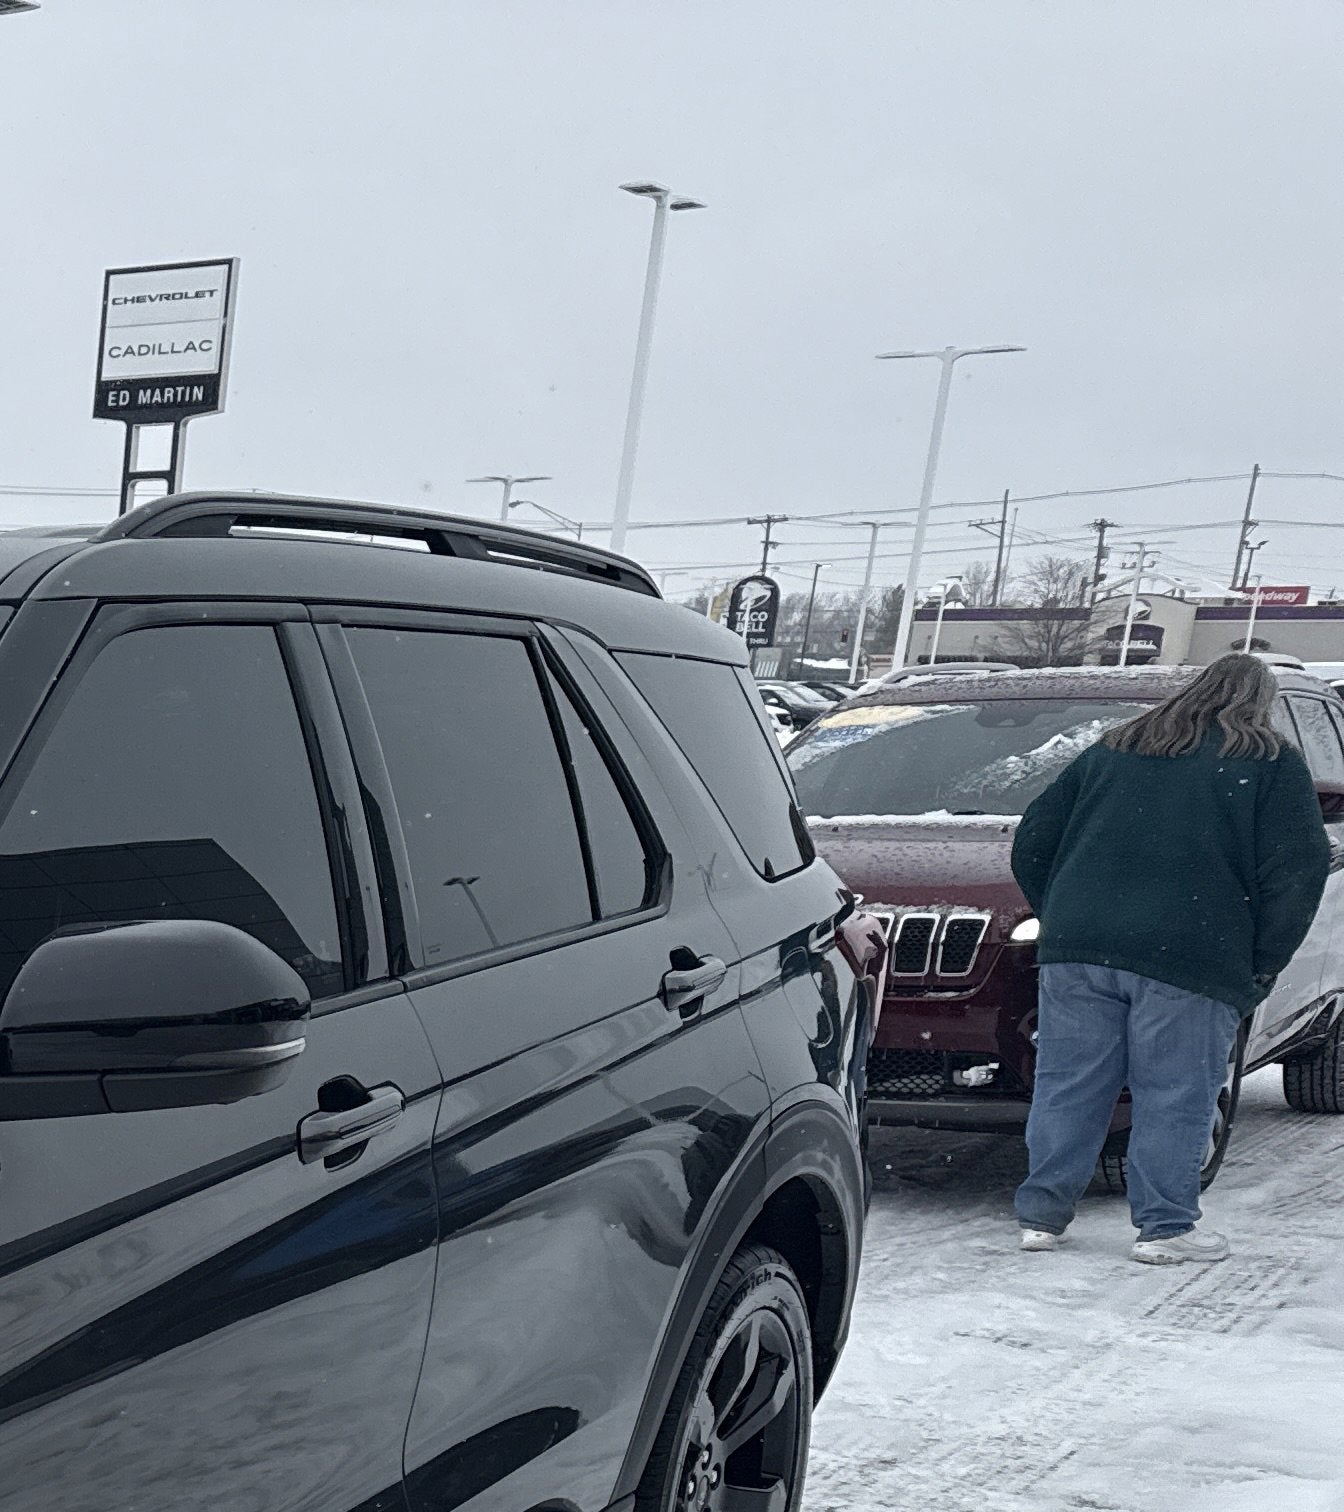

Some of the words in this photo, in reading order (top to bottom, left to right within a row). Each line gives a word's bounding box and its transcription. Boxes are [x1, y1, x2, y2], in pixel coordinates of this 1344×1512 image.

[111, 289, 218, 306] CHEVROLET
[108, 339, 213, 358] CADILLAC
[107, 390, 130, 407] ED
[137, 385, 204, 405] MARTIN
